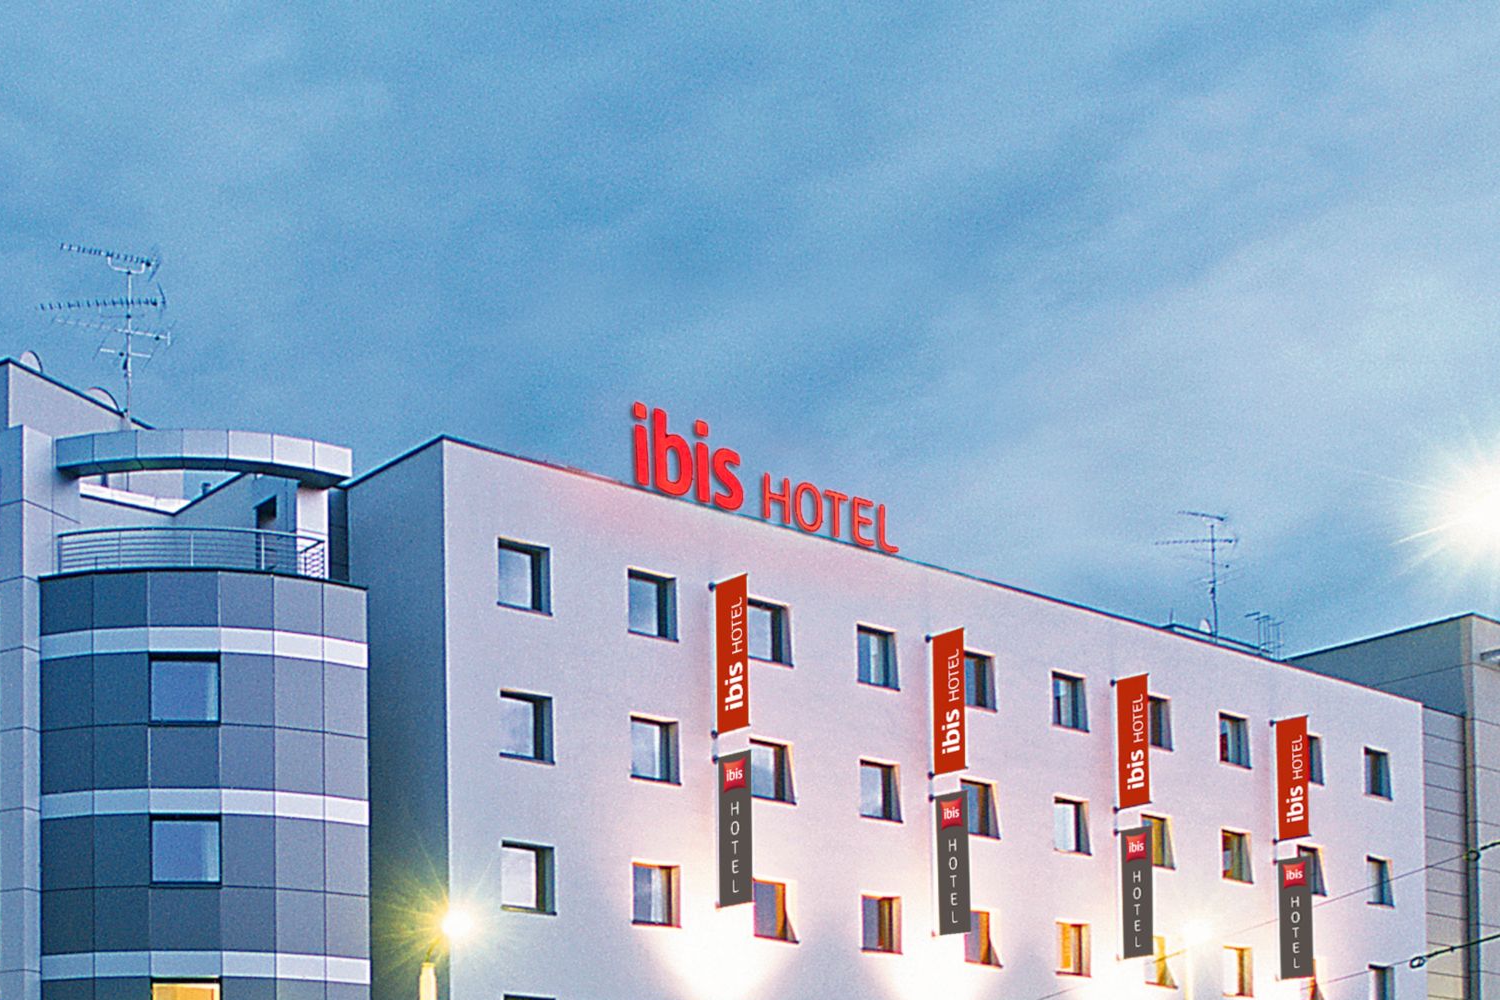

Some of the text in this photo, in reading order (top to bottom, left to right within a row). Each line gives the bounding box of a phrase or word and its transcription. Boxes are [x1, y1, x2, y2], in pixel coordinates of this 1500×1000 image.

[632, 401, 899, 553] ibis HOTEL
[724, 596, 744, 712] ibis HOTEL
[941, 648, 961, 755] ibis HOTEL
[1126, 694, 1146, 790] ibis HOTEL
[726, 767, 743, 782] ibis
[943, 806, 960, 820] ibis
[1285, 734, 1305, 823] ibis HOTEL
[730, 801, 740, 894] HOTEL
[948, 838, 958, 925] HOTEL
[1128, 840, 1145, 853] ibis
[1285, 868, 1303, 881] ibis
[1132, 870, 1142, 948] HOTEL
[1290, 896, 1301, 969] HOTEL
